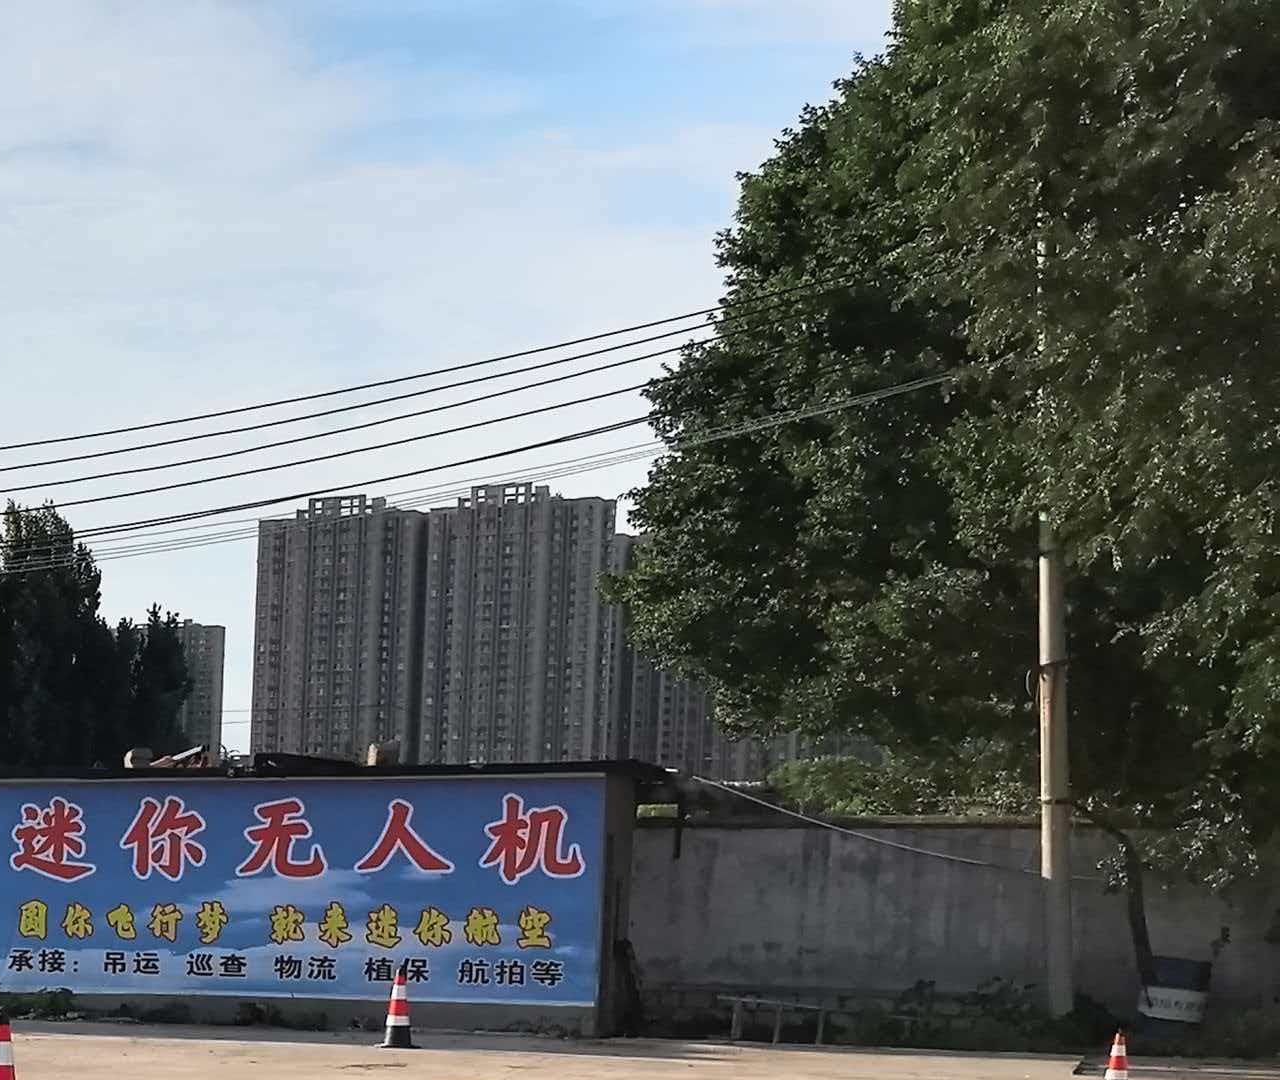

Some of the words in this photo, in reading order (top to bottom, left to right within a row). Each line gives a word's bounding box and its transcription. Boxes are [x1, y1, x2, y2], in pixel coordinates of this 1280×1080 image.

[9, 793, 586, 885] 迷你无人机
[186, 953, 247, 978] 巡查
[274, 955, 337, 981] 物流
[458, 959, 564, 986] 航拍等
